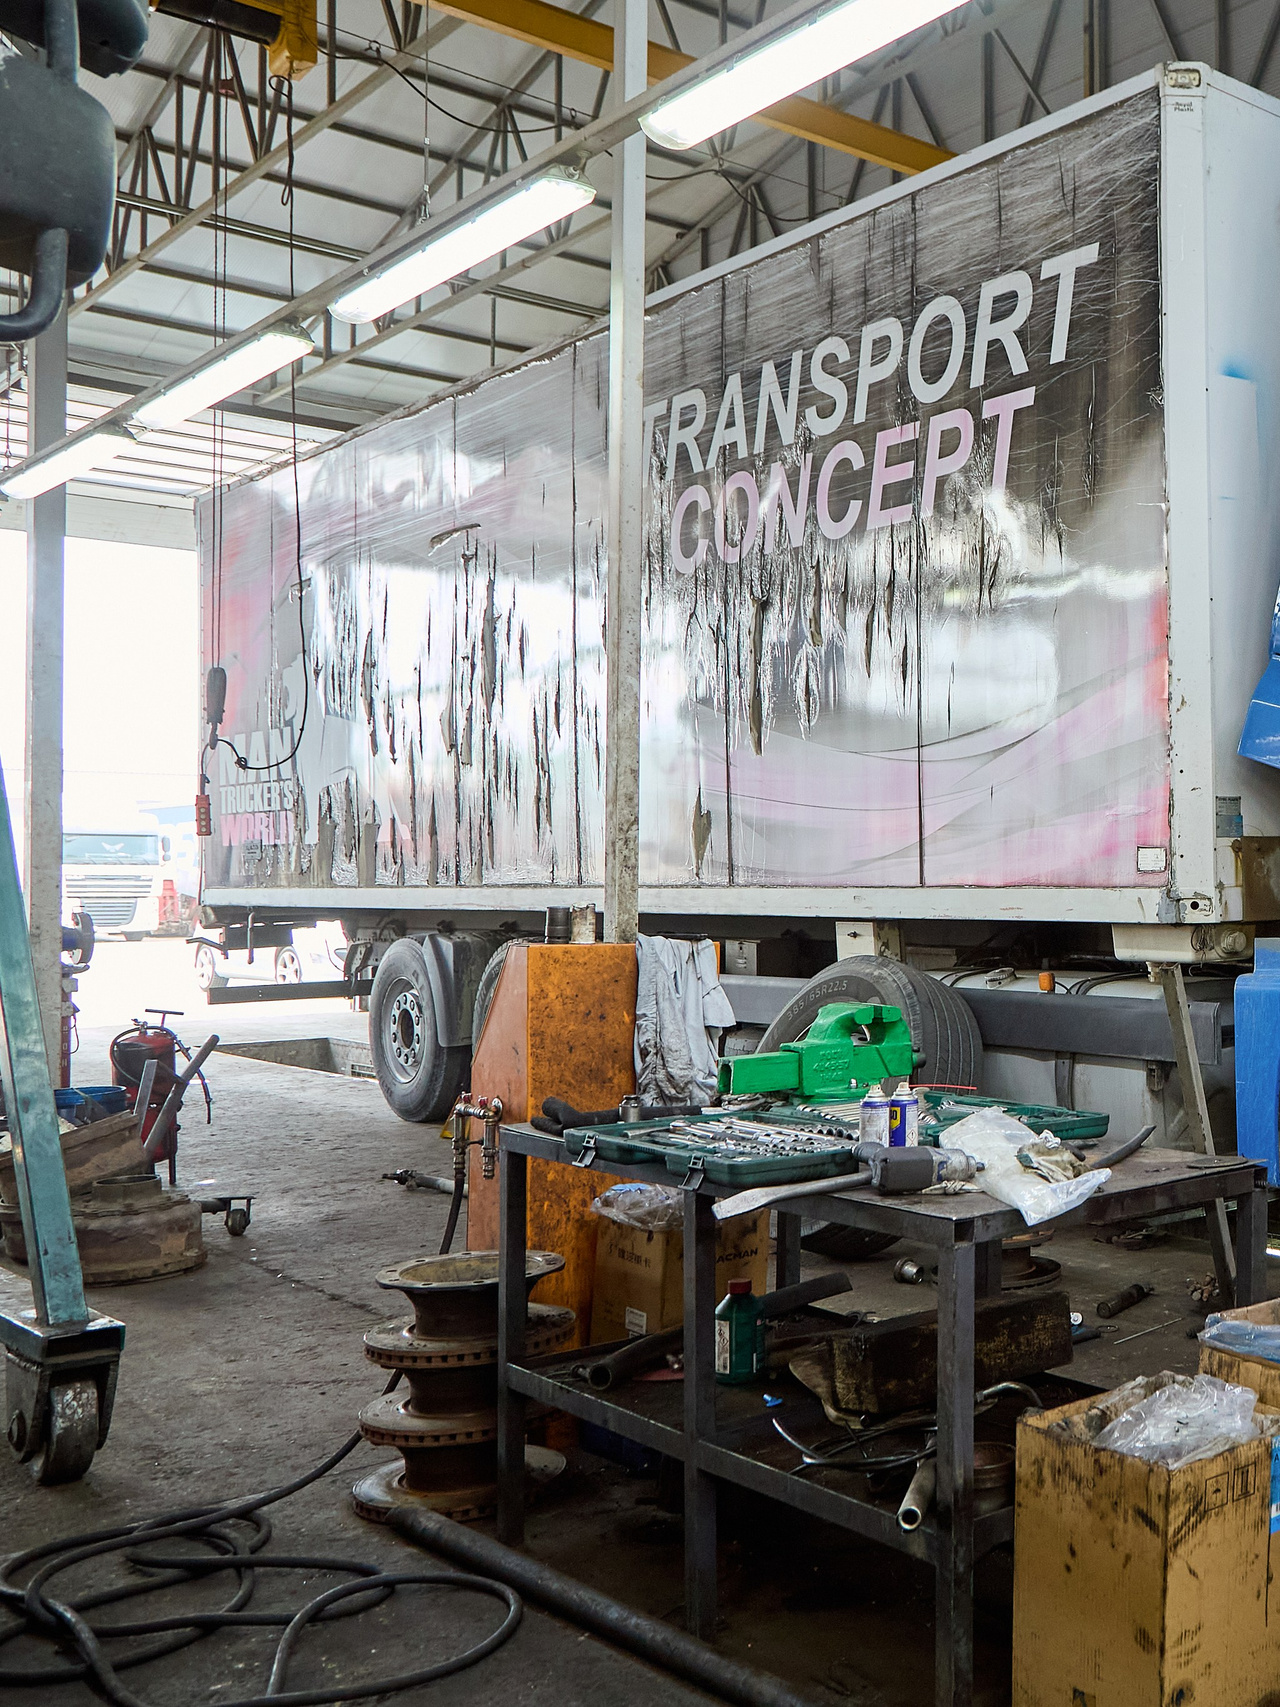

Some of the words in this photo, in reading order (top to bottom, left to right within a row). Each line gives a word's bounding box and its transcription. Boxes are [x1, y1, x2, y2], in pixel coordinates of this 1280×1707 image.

[643, 242, 1100, 488] TRANSPORT
[670, 386, 1036, 574] CONCEPT
[219, 726, 292, 786] MAN
[219, 780, 294, 815] TRUCKER'S
[219, 810, 294, 847] WORLD
[716, 1247, 759, 1264] ACMAN
